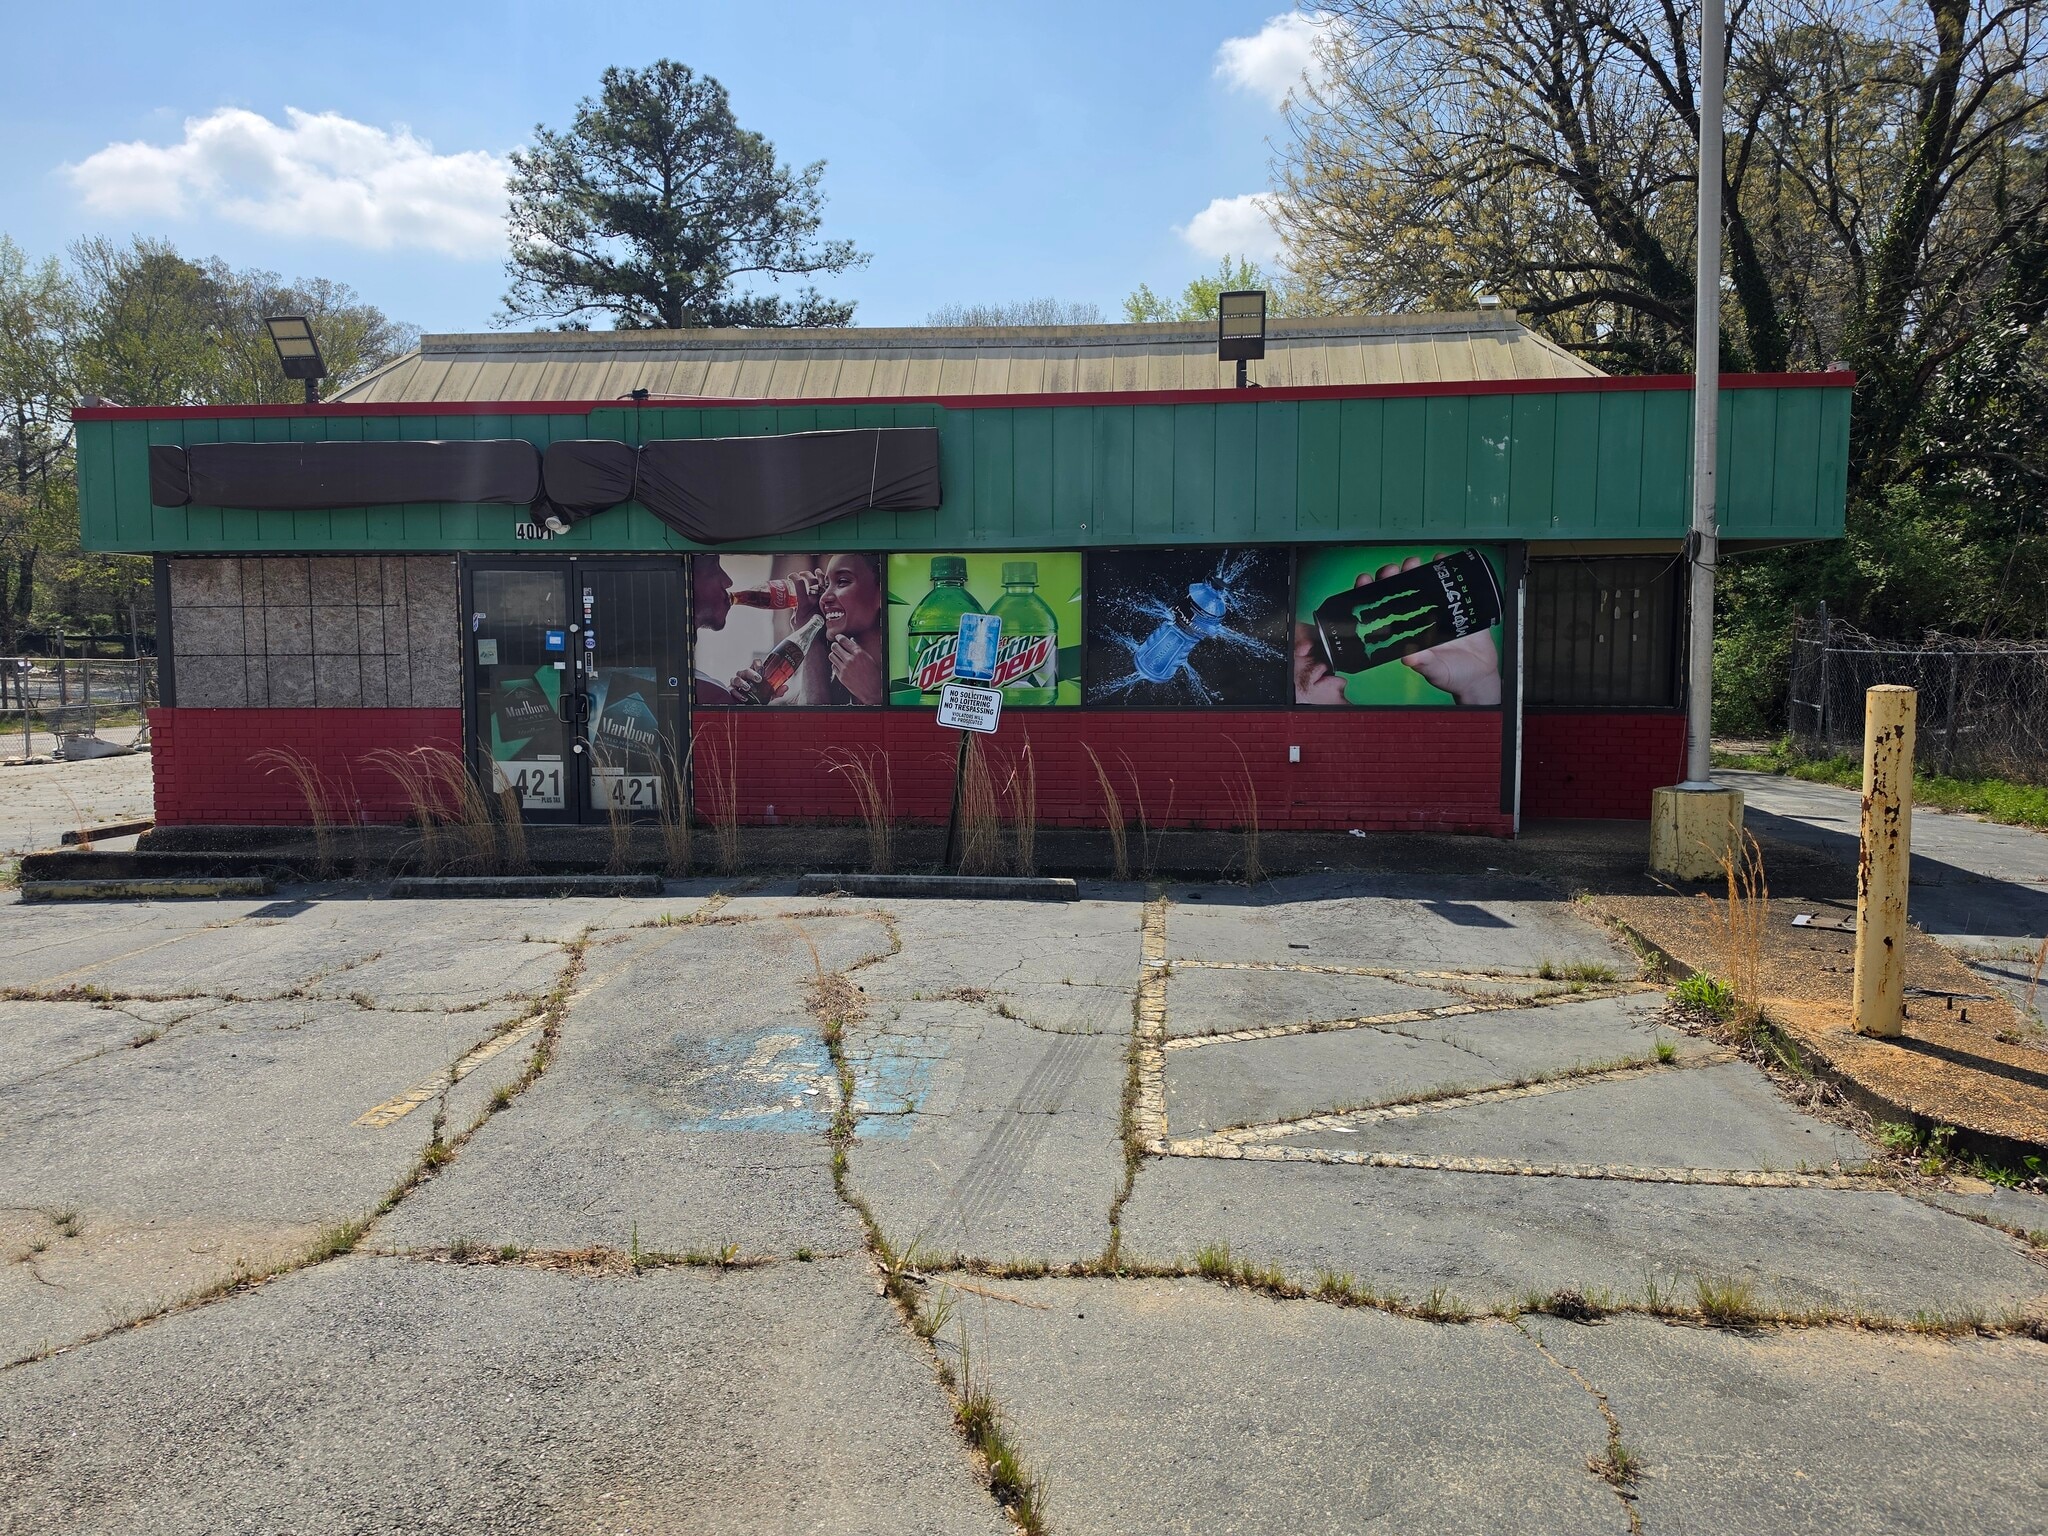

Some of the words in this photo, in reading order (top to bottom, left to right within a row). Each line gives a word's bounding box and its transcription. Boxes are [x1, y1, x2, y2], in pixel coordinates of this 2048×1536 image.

[1451, 566, 1477, 625] ENERGY
[960, 691, 993, 702] SOLICITING
[960, 698, 991, 708] LOITERING
[505, 700, 550, 719] Marlboro
[954, 704, 994, 715] TRESPASSING
[602, 716, 655, 745] Marlboro
